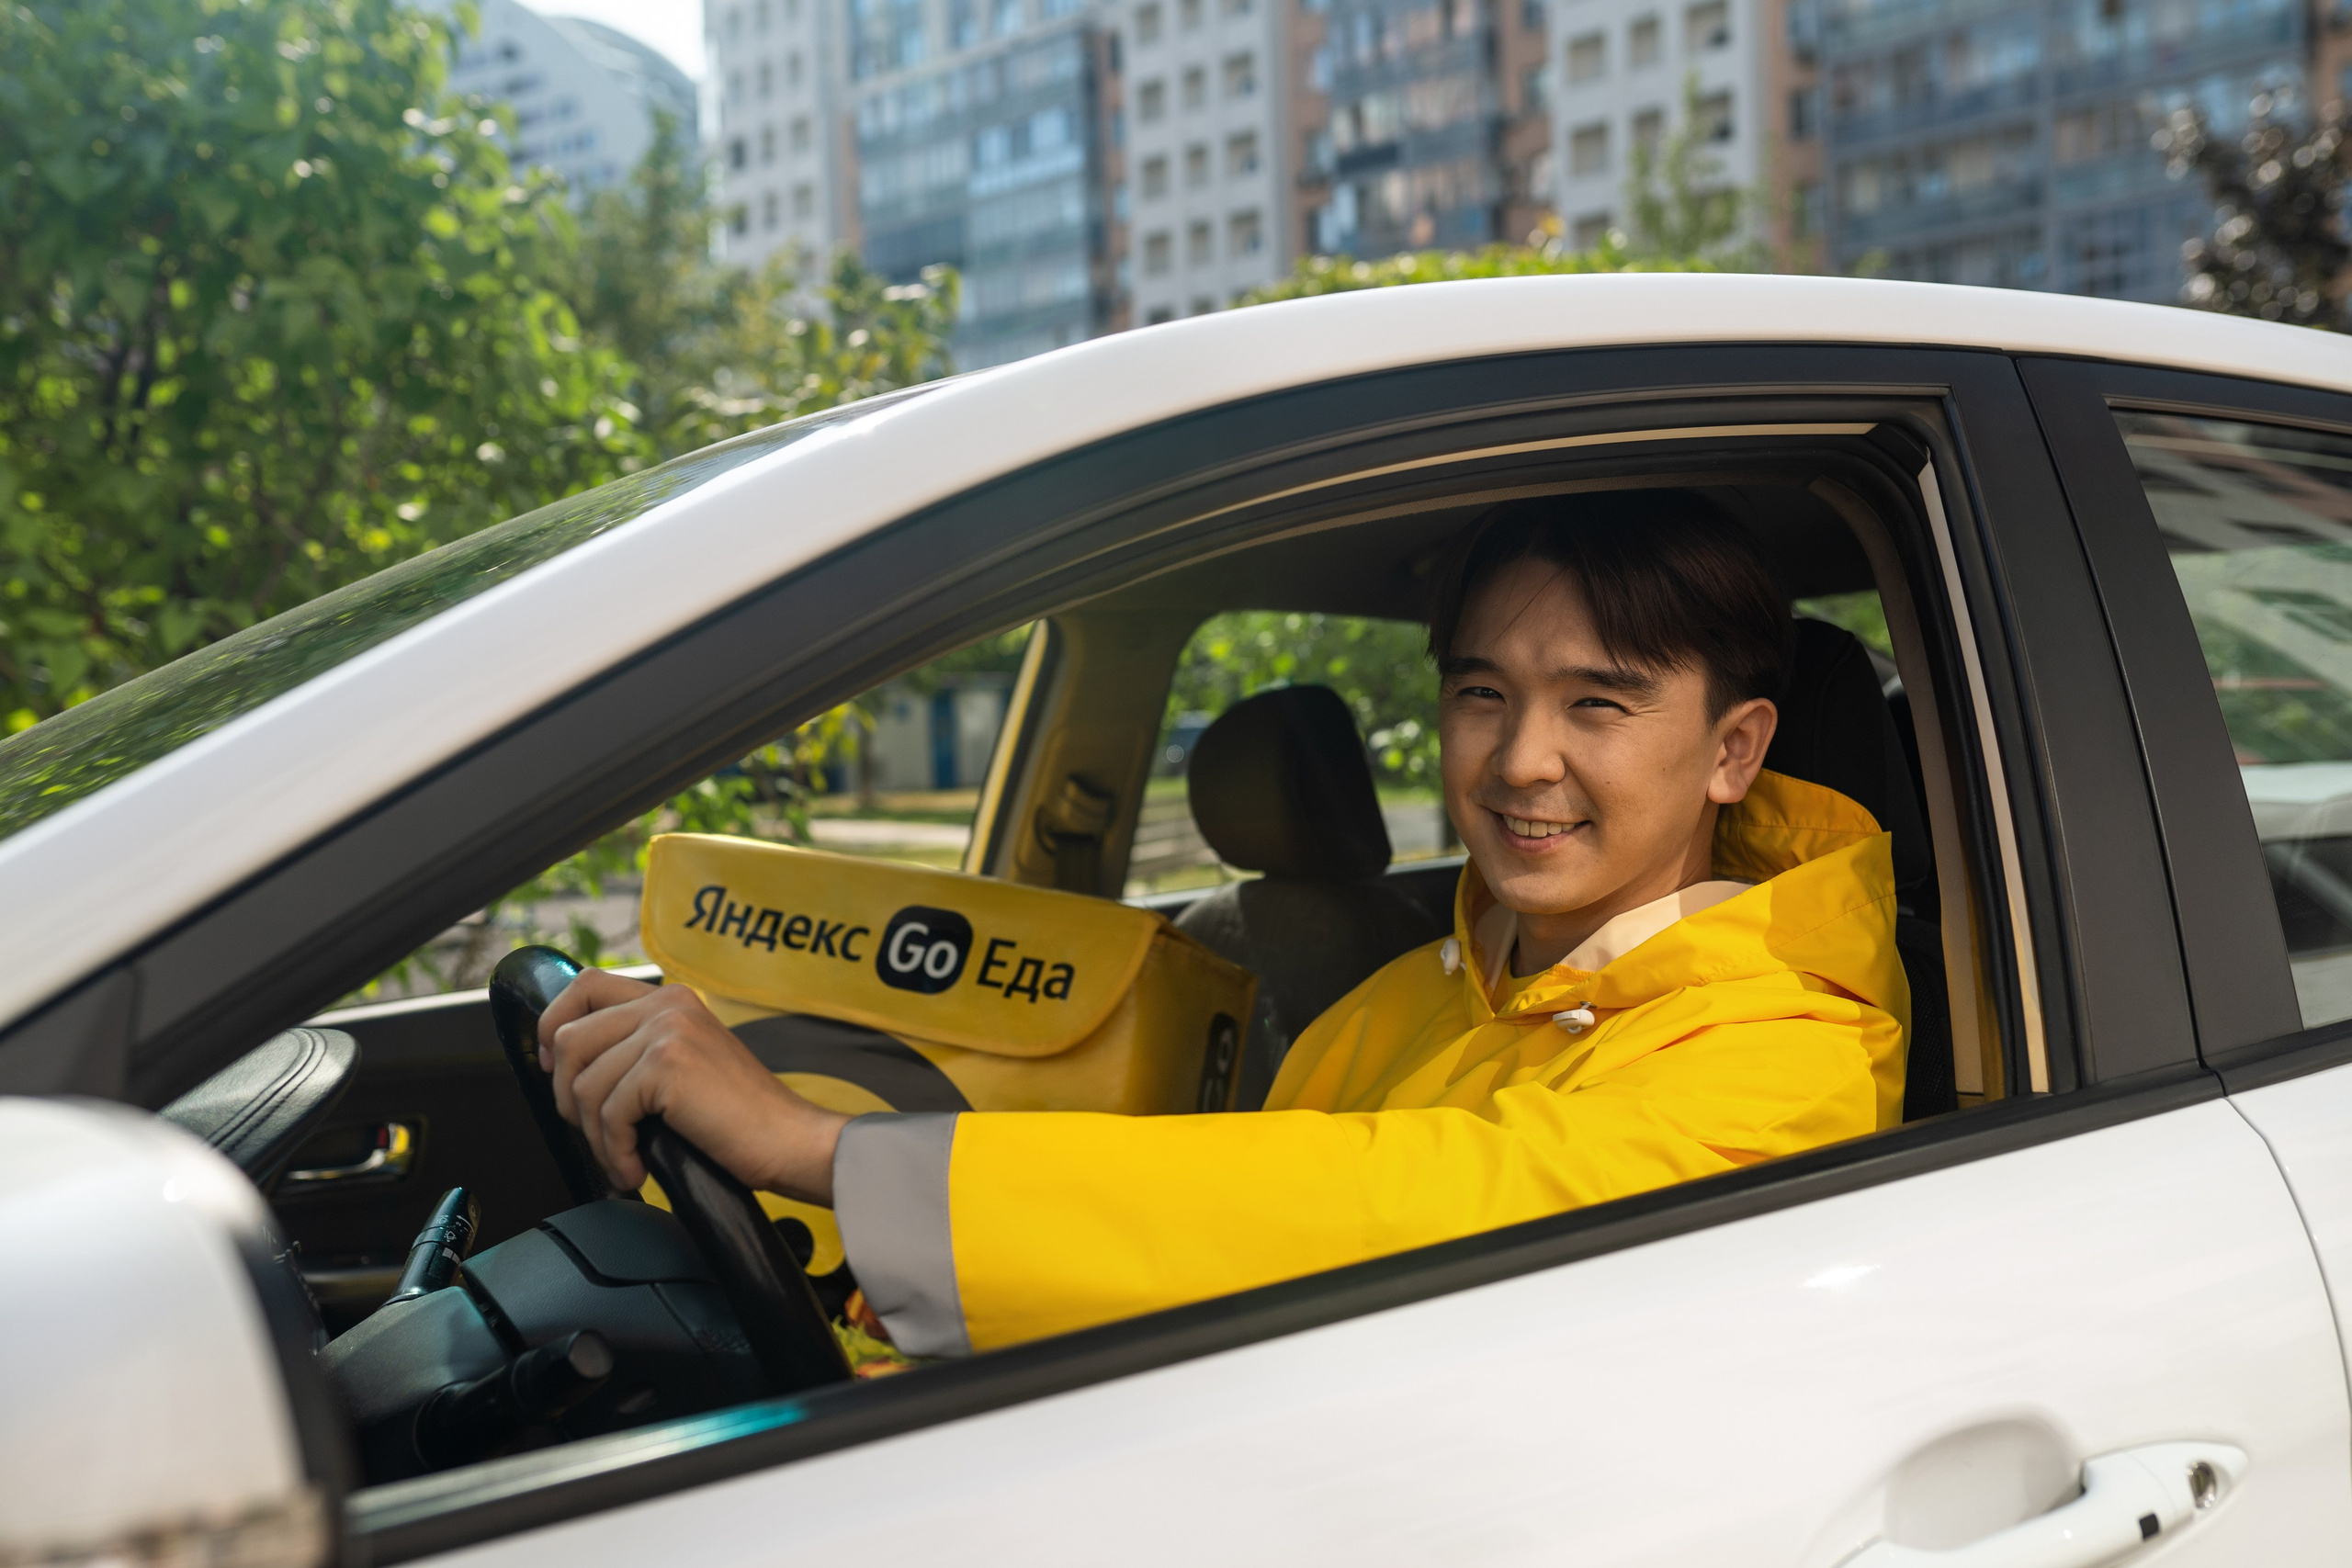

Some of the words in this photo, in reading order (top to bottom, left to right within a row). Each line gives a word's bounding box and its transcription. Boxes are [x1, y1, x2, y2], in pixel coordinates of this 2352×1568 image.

[684, 885, 870, 963] Яндекс
[888, 921, 958, 979] Go
[976, 937, 1076, 1004] Еда
